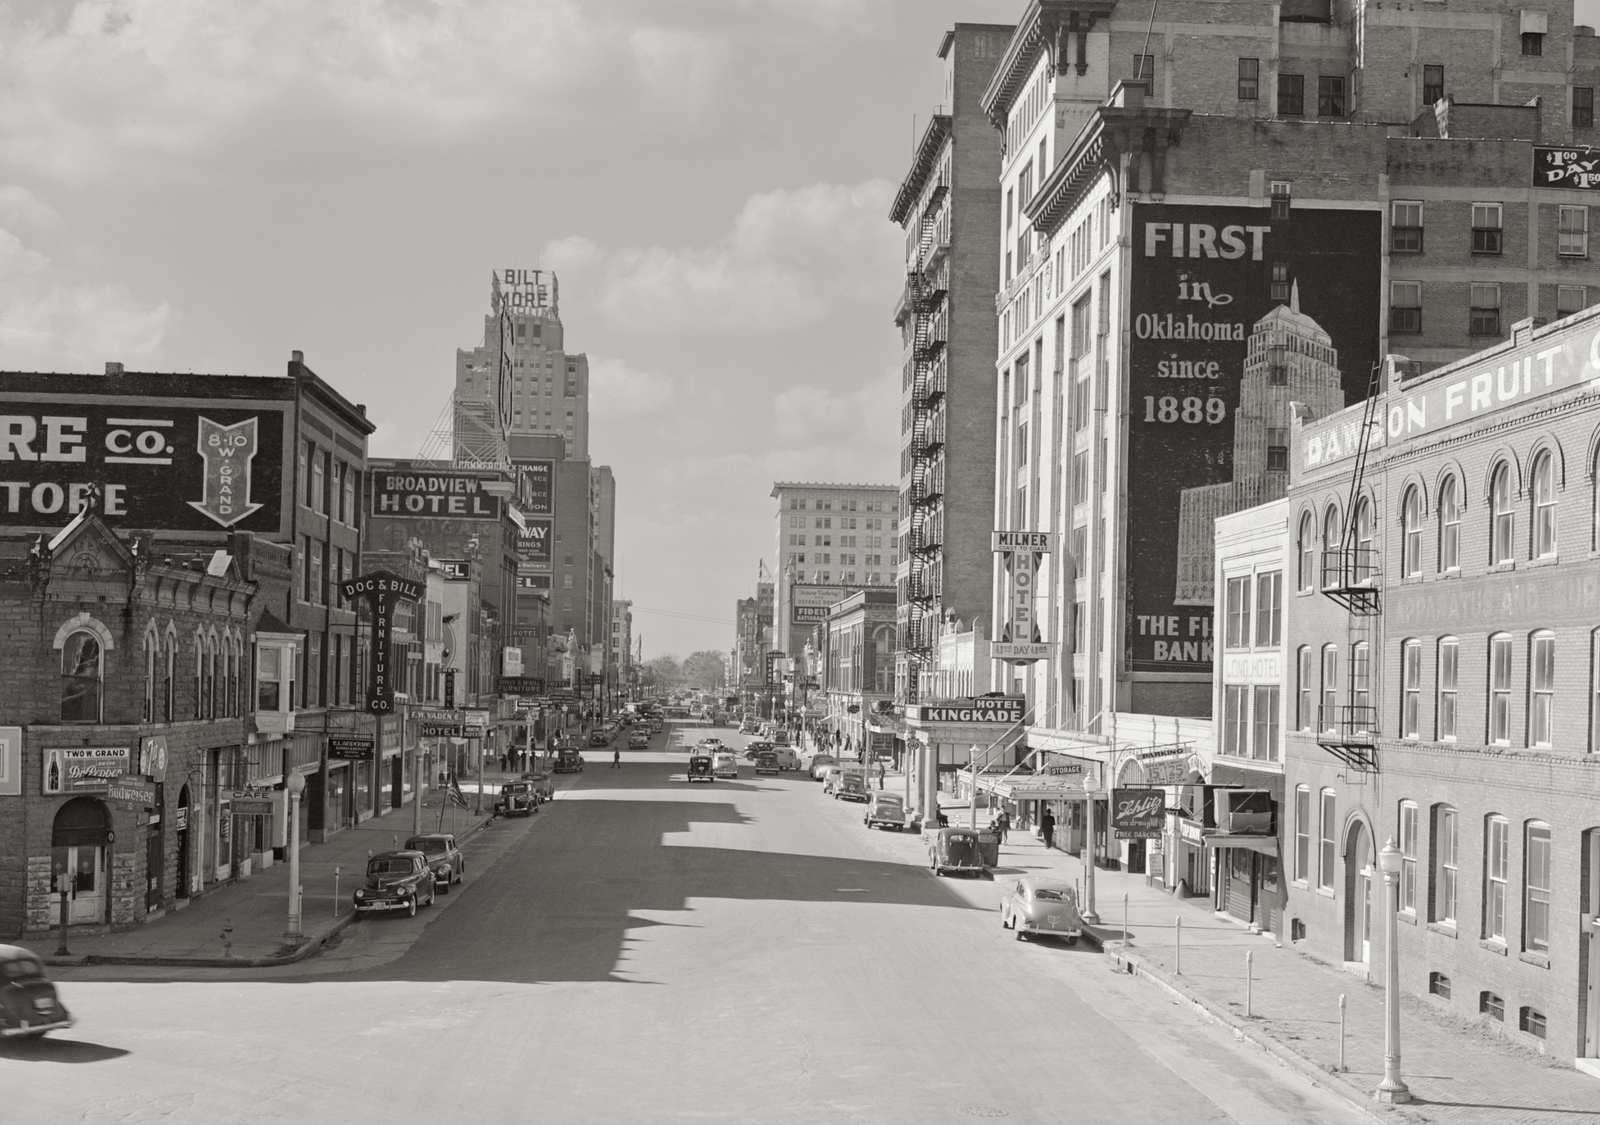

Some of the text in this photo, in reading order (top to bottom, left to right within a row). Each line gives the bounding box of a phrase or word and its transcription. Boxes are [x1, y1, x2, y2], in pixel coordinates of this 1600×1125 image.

[1546, 160, 1599, 182] DAY
[1144, 222, 1272, 261] FIRST
[505, 269, 542, 285] BILT
[498, 292, 548, 308] MORE
[1177, 273, 1234, 309] in
[1135, 312, 1246, 341] Oklahoma
[1157, 353, 1220, 379] since
[1446, 344, 1564, 420] FRUIT
[1143, 395, 1226, 424] 1889
[104, 429, 175, 455] CO.
[219, 466, 233, 515] GRAND
[386, 475, 479, 493] BROADVIEW
[380, 493, 491, 514] HOTEL
[998, 533, 1048, 546] MILNER
[345, 579, 418, 597] DOC & BILL
[1015, 554, 1031, 640] HOTEL
[1137, 615, 1180, 636] THE
[376, 593, 386, 696] FURNITURE
[1013, 645, 1031, 656] DAY
[1153, 640, 1214, 662] BANK
[1226, 657, 1280, 678] LONG HOTEL
[371, 700, 390, 709] CO.
[976, 700, 1021, 709] HOTEL
[411, 711, 426, 719] F.W.
[426, 712, 452, 720] VADEN
[928, 709, 1021, 722] KINGKADE
[422, 727, 458, 736] HOTEL
[95, 749, 125, 757] GRAND
[1142, 748, 1184, 759] PARKING
[1051, 765, 1080, 775] STORAGE
[107, 783, 154, 803] Budweiser
[232, 791, 270, 799] CAFE
[1115, 796, 1162, 820] Schlitz
[1115, 830, 1161, 839] FREE DANCING
